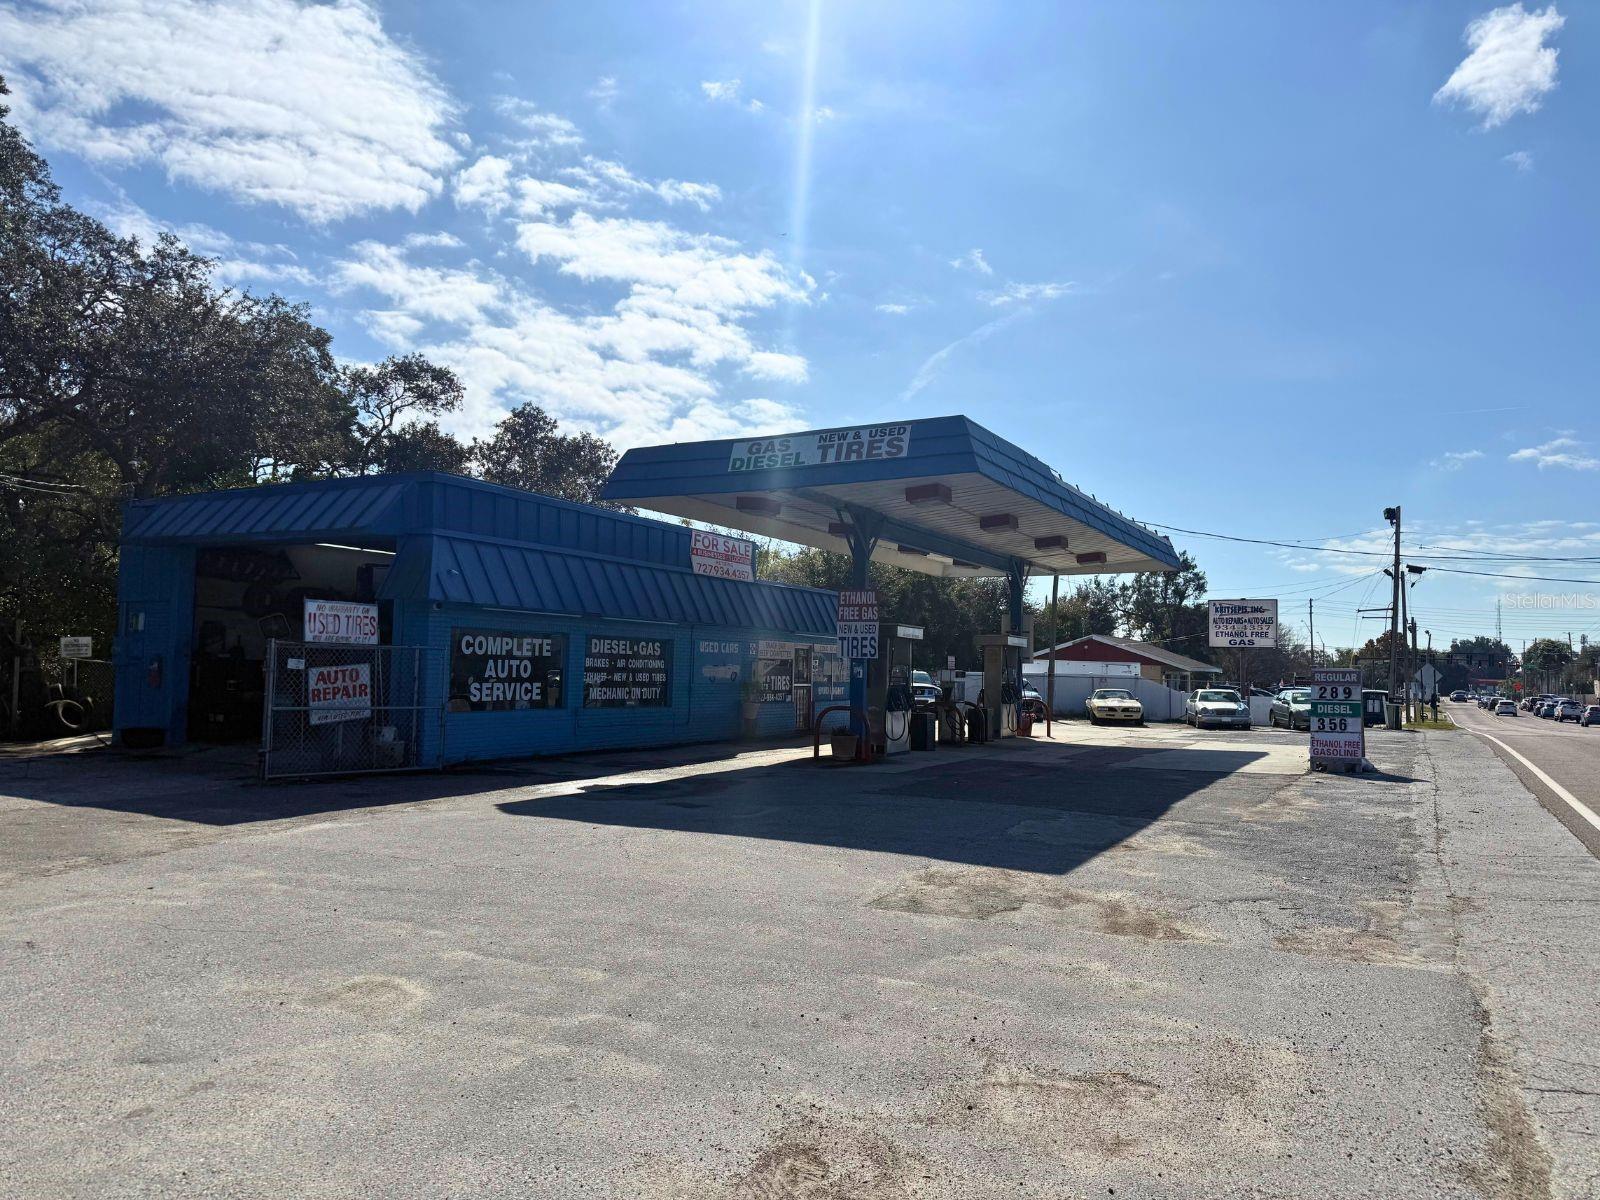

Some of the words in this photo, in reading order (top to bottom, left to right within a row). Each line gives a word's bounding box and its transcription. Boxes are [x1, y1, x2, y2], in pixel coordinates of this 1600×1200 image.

[818, 432, 849, 444] NEW
[852, 430, 862, 440] &
[868, 426, 907, 439] USED
[747, 438, 791, 456] GAS
[817, 437, 905, 463] TIRES
[730, 452, 805, 471] DIESEL
[693, 533, 719, 551] FOR
[723, 540, 751, 557] SALE
[840, 591, 878, 605] ETHANOL
[839, 606, 860, 620] FREE
[862, 606, 878, 620] GAS
[308, 612, 340, 634] USED
[345, 614, 376, 636] TIRES
[1213, 617, 1225, 625] AUTO
[1225, 617, 1244, 625] REPAIRS
[1247, 617, 1260, 625] AUTO
[1260, 617, 1274, 625] SALES
[838, 624, 854, 634] NEW
[860, 624, 877, 634] USED
[461, 635, 552, 657] COMPLETE
[592, 638, 633, 655] DIESEL
[639, 641, 661, 655] GAS
[700, 641, 719, 653] USED
[721, 642, 739, 654] CARS
[839, 636, 877, 657] TIRES
[485, 659, 532, 679] AUTO
[585, 658, 609, 668] BRAKES
[616, 659, 626, 668] AIR
[628, 659, 665, 669] CONDITIONING
[315, 668, 360, 686] AUTO
[613, 672, 627, 682] NEW
[629, 673, 633, 682] &
[635, 672, 650, 682] USED
[652, 672, 667, 682] TIRES
[770, 675, 790, 690] TIRES
[1314, 673, 1357, 682] REGULAR
[311, 683, 368, 702] REPAIR
[469, 682, 542, 702] SERVICE
[589, 687, 630, 700] MECHANIC
[631, 687, 641, 700] ON
[642, 687, 661, 700] DUTY
[1319, 686, 1352, 699] 289
[1317, 704, 1352, 714] DIESEL
[1317, 718, 1347, 731] 356
[1312, 739, 1342, 749] ETHANOL
[1344, 740, 1360, 750] FREE
[1313, 748, 1359, 758] GASOLINE
